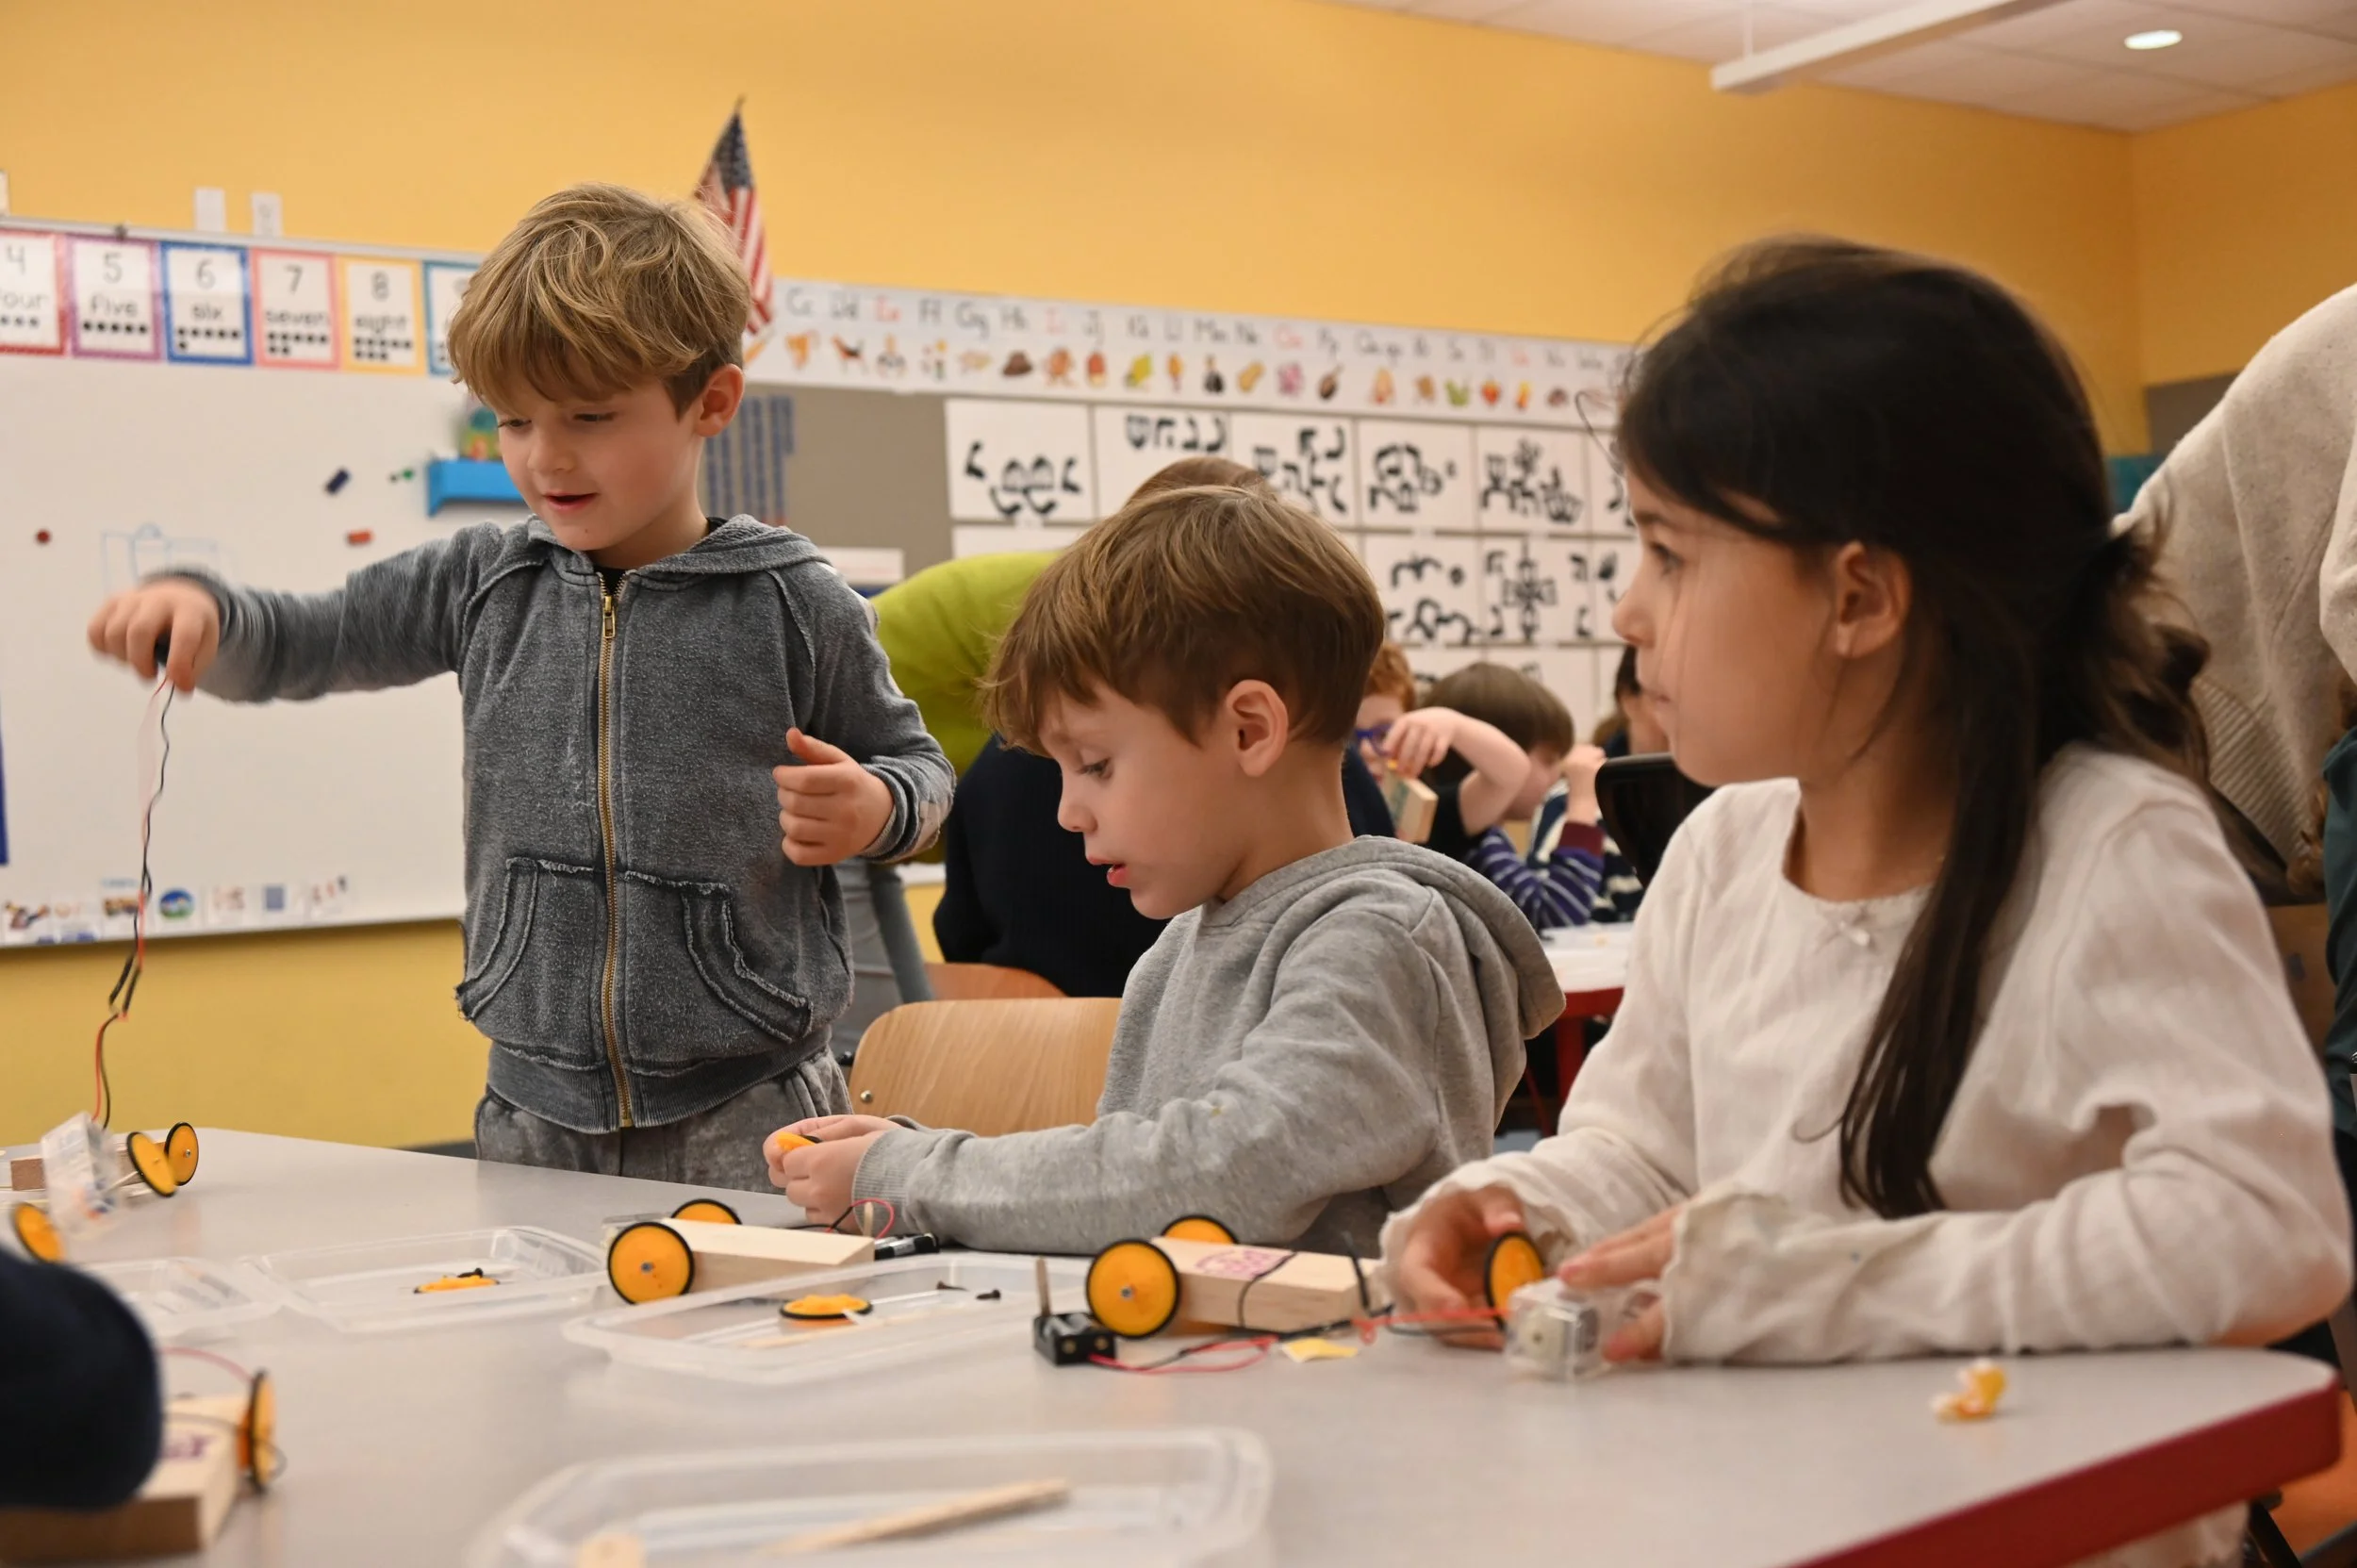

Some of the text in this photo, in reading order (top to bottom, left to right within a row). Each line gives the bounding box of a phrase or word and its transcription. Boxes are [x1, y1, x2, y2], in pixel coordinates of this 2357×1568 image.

[7, 244, 26, 275] 4
[103, 251, 123, 284] 5
[195, 257, 217, 290] 6
[285, 264, 304, 295] 7
[371, 270, 390, 302] 8
[0, 286, 48, 310] our
[90, 292, 139, 317] five
[191, 302, 223, 322] six
[265, 309, 330, 326] seven
[354, 315, 408, 335] eight
